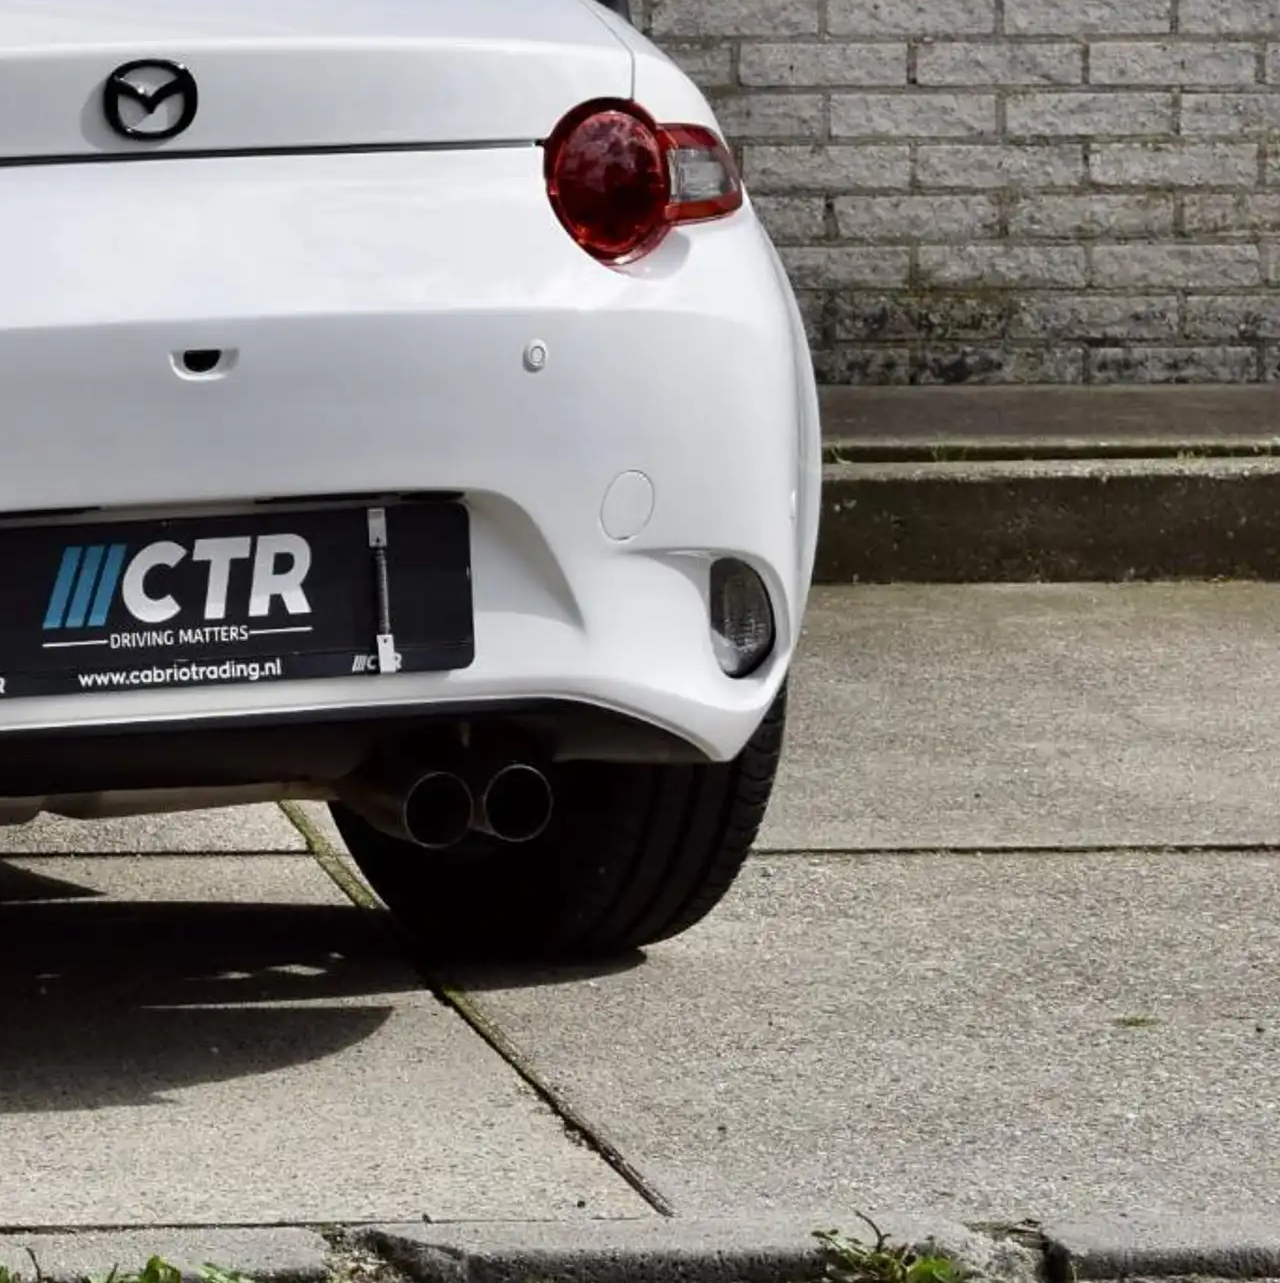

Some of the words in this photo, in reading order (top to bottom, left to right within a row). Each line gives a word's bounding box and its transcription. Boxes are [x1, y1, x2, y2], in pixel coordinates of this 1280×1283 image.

[122, 533, 313, 623] CTR
[110, 629, 174, 649] DRIVING
[179, 625, 249, 645] MATTERS
[78, 658, 283, 687] www.cabriotrading.nl
